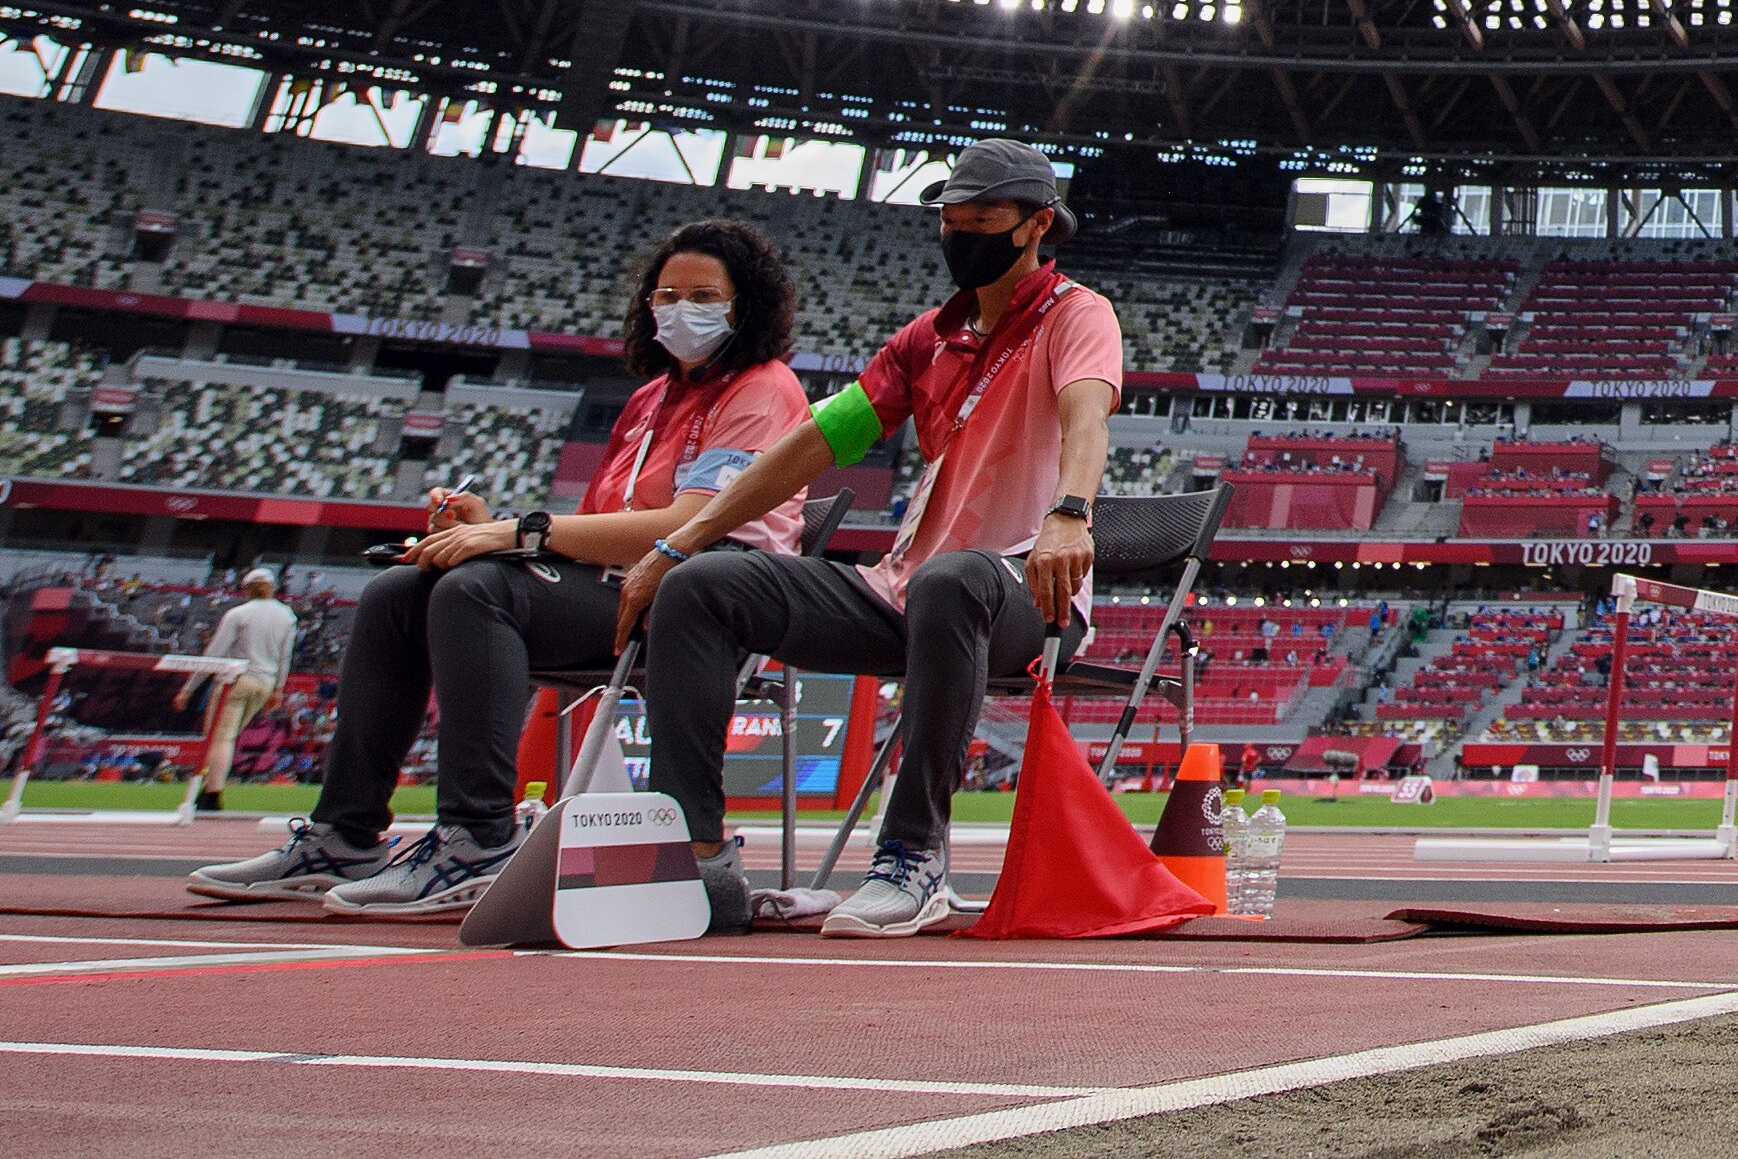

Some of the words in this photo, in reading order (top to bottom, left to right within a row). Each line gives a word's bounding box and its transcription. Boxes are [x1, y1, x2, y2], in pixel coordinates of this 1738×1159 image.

[988, 346, 1013, 375] TOKYO
[976, 372, 994, 393] 2020
[1223, 375, 1282, 392] TOKYO
[1287, 376, 1330, 393] 2020
[1592, 381, 1646, 397] TOKYO
[1650, 380, 1692, 396] 2020
[1520, 542, 1594, 564] TOKYO
[1597, 542, 1652, 564] 2020
[822, 718, 844, 748] 7
[571, 813, 613, 828] TOKYO
[614, 811, 643, 827] 2020
